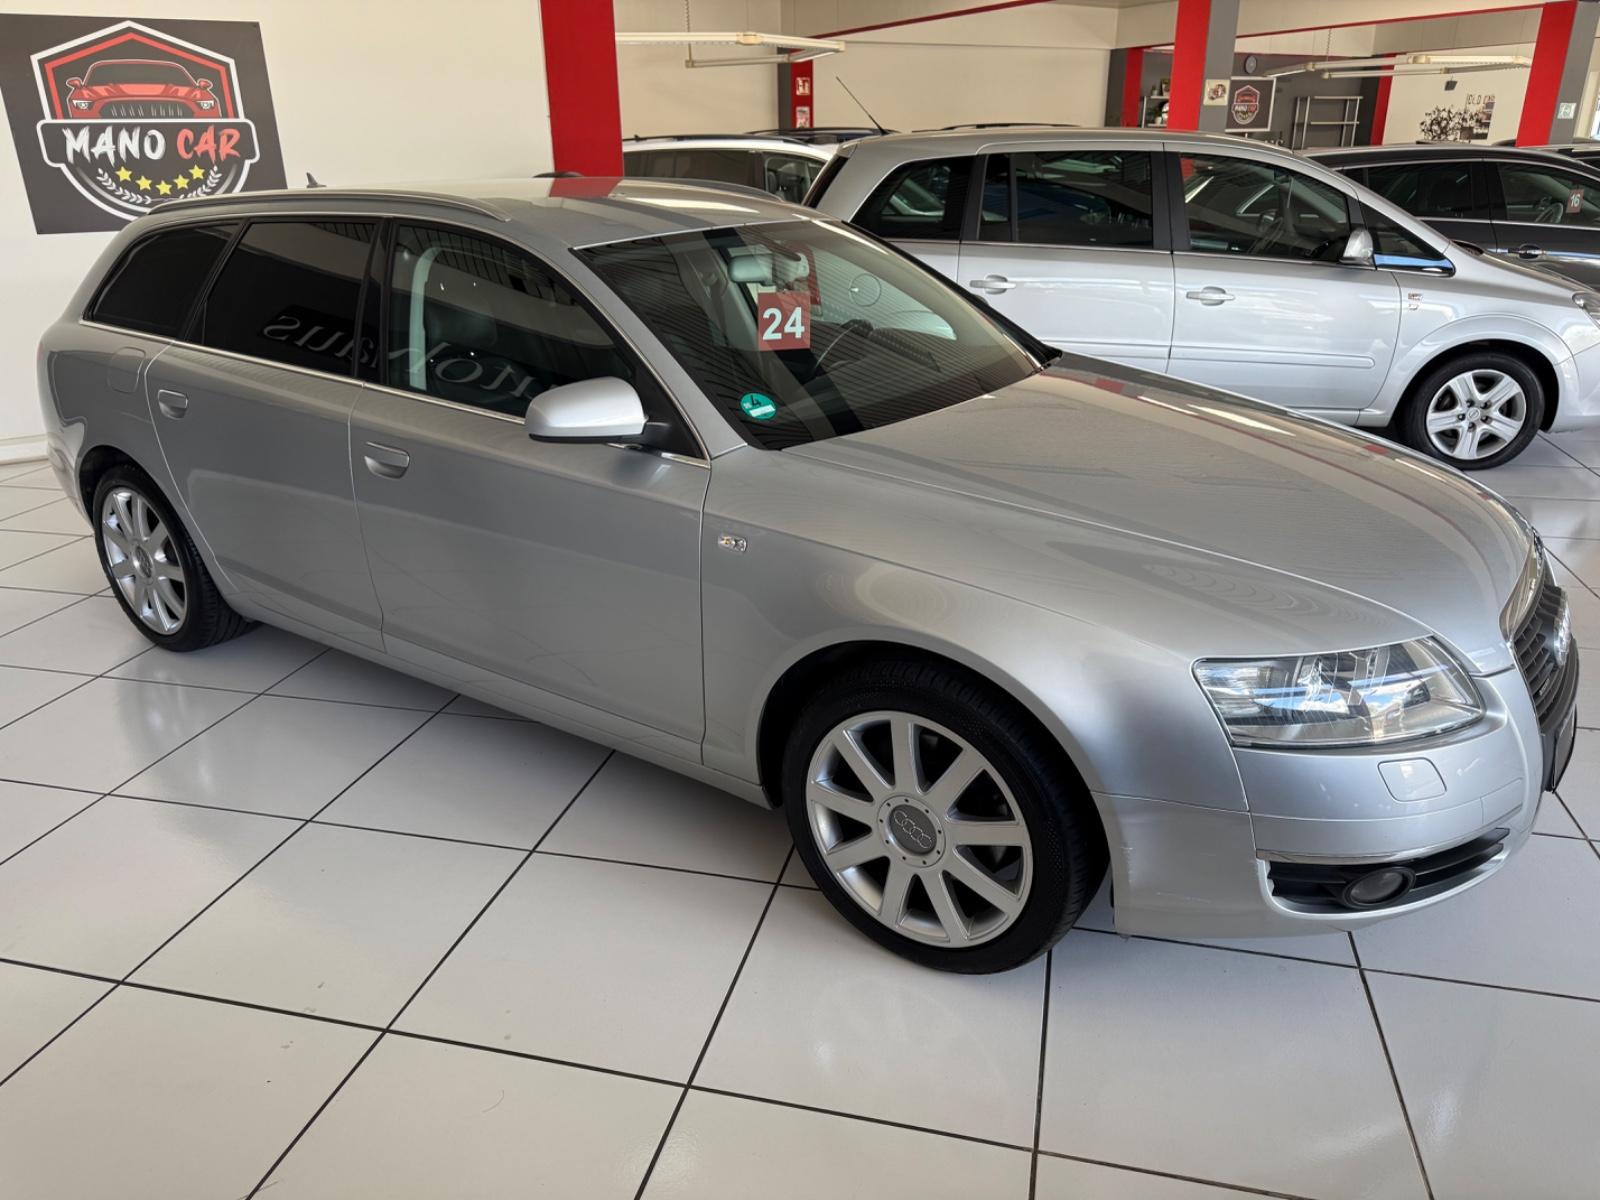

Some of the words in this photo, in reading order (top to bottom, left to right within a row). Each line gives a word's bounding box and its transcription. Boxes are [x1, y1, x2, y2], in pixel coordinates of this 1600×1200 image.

[62, 125, 167, 167] MANO
[176, 125, 241, 165] CAR
[762, 306, 805, 341] 24
